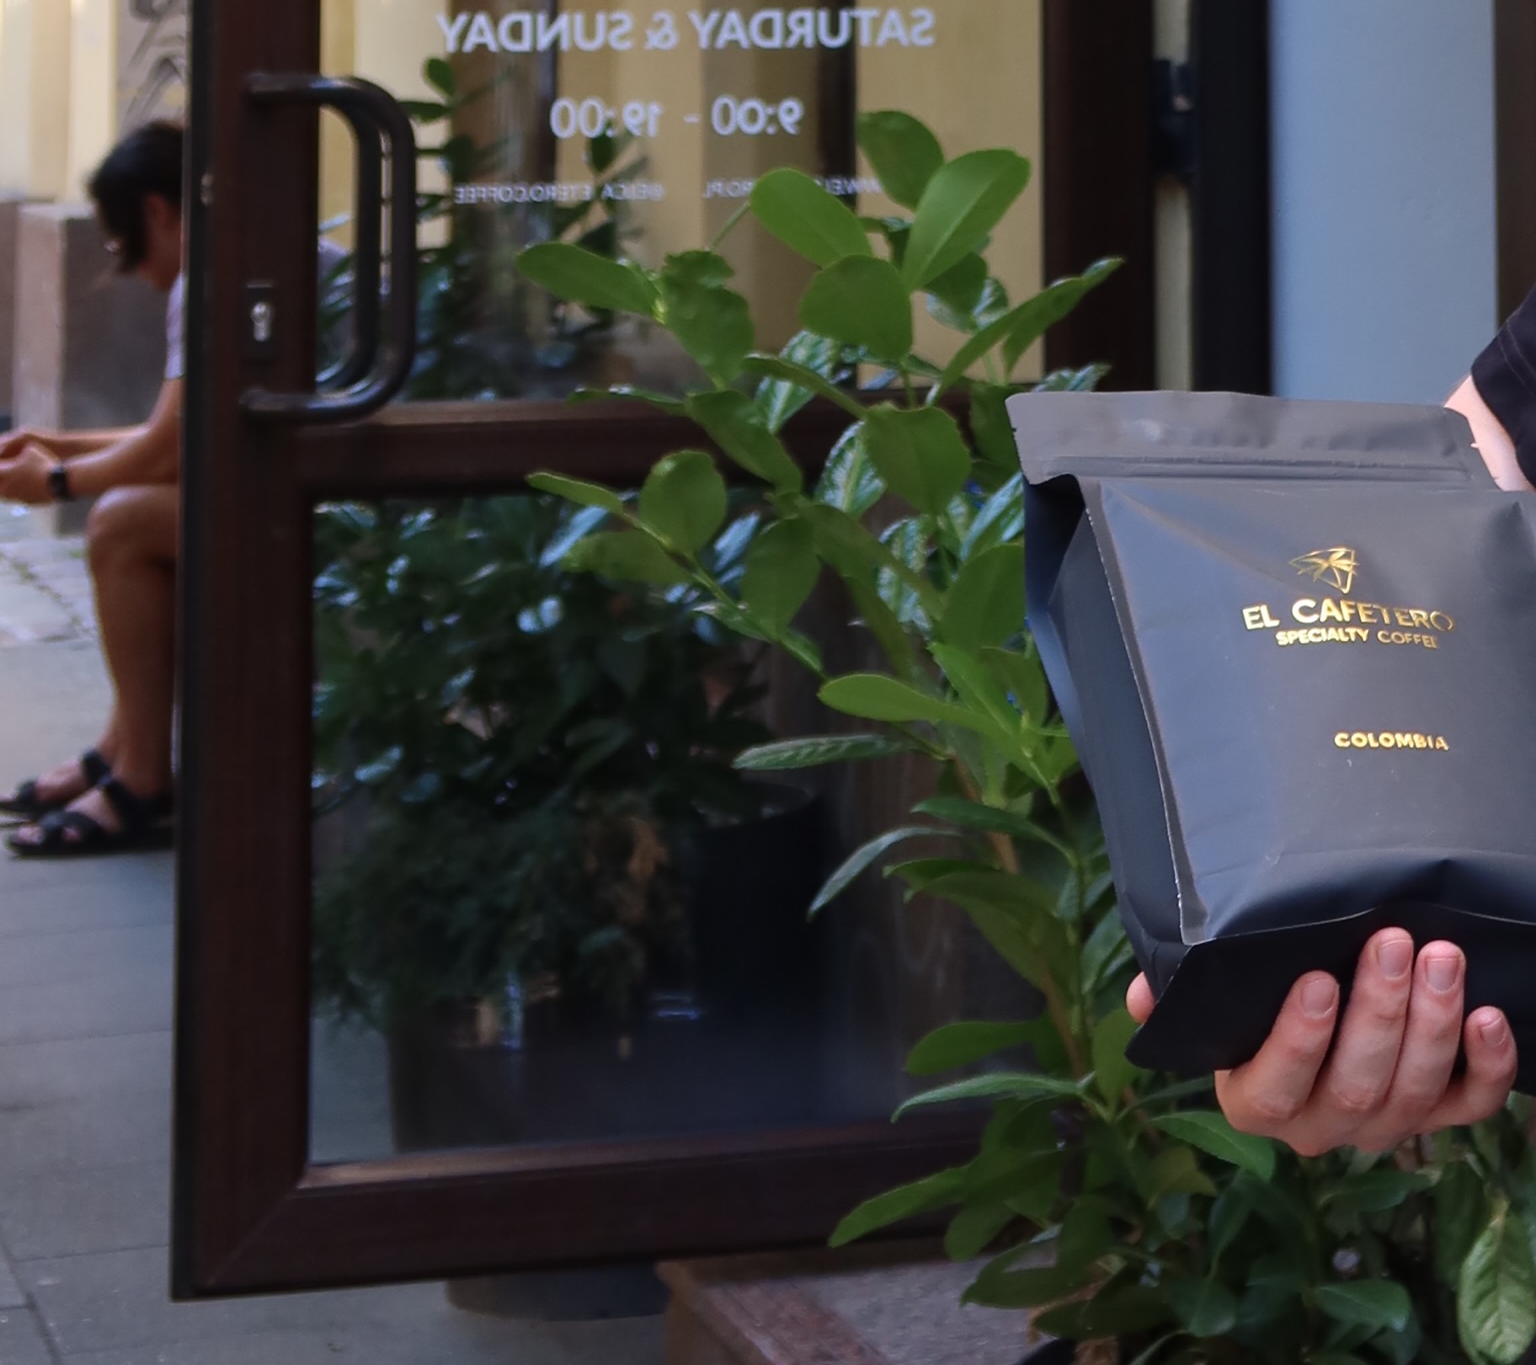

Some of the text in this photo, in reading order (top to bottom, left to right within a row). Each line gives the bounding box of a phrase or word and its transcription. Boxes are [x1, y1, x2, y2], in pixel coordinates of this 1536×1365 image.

[1242, 599, 1454, 631] EL CAFETERO
[1275, 627, 1369, 646] SPECIALTY
[1334, 731, 1449, 751] COLOMBIA
